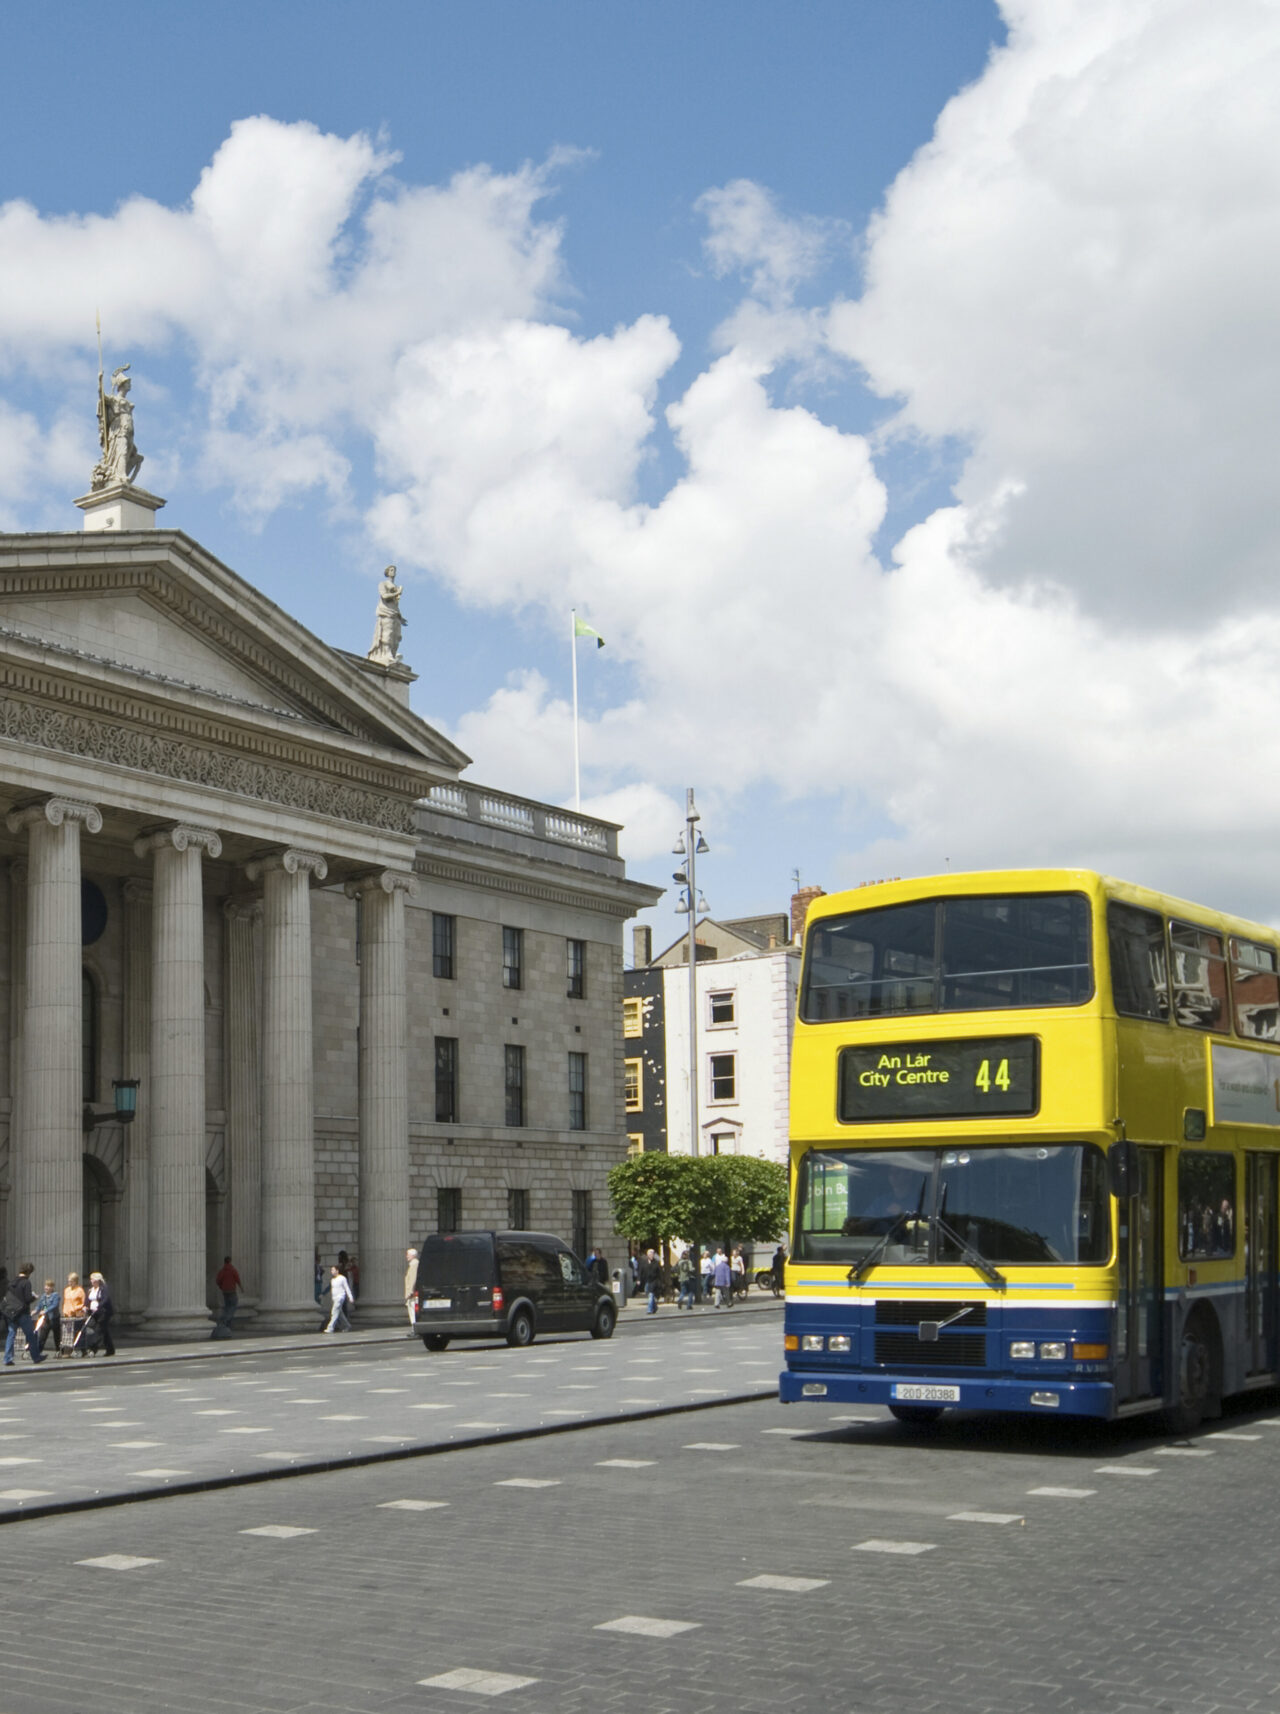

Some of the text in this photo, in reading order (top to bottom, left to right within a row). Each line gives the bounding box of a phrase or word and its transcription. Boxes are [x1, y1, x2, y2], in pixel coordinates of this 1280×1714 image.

[878, 1053, 931, 1069] An Lár
[859, 1070, 949, 1087] City Centre
[975, 1059, 1011, 1093] 44
